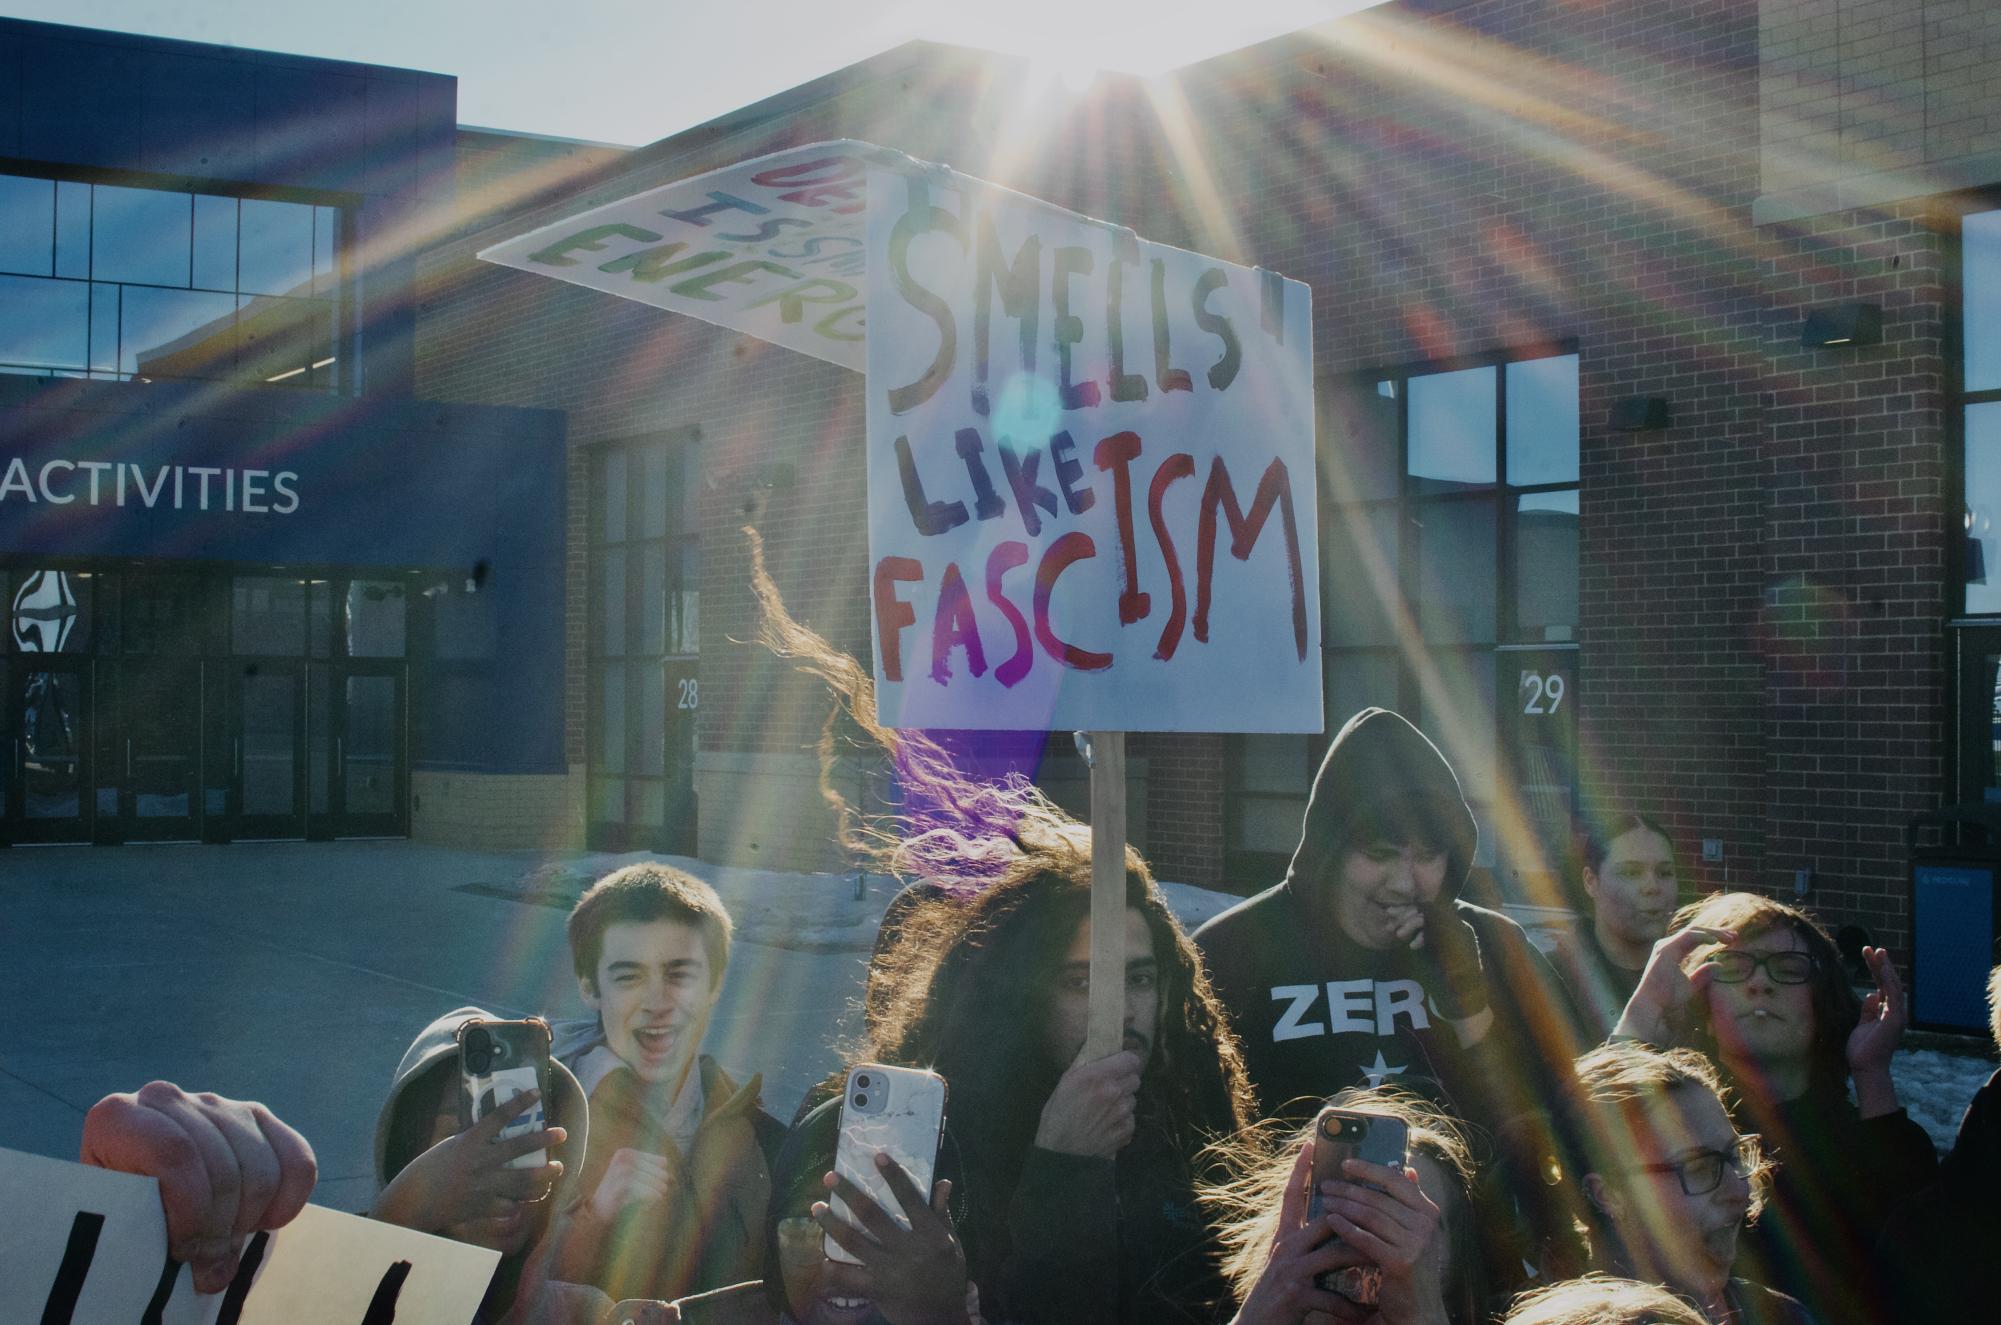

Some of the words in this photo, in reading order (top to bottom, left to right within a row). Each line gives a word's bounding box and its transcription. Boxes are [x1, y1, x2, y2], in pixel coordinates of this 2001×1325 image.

[888, 206, 1242, 417] SMELLS
[0, 457, 300, 514] ACTIVITIES
[894, 427, 1096, 537] LIKE
[678, 678, 698, 709] 28
[1523, 674, 1565, 715] 29
[1270, 978, 1440, 1042] ZER
